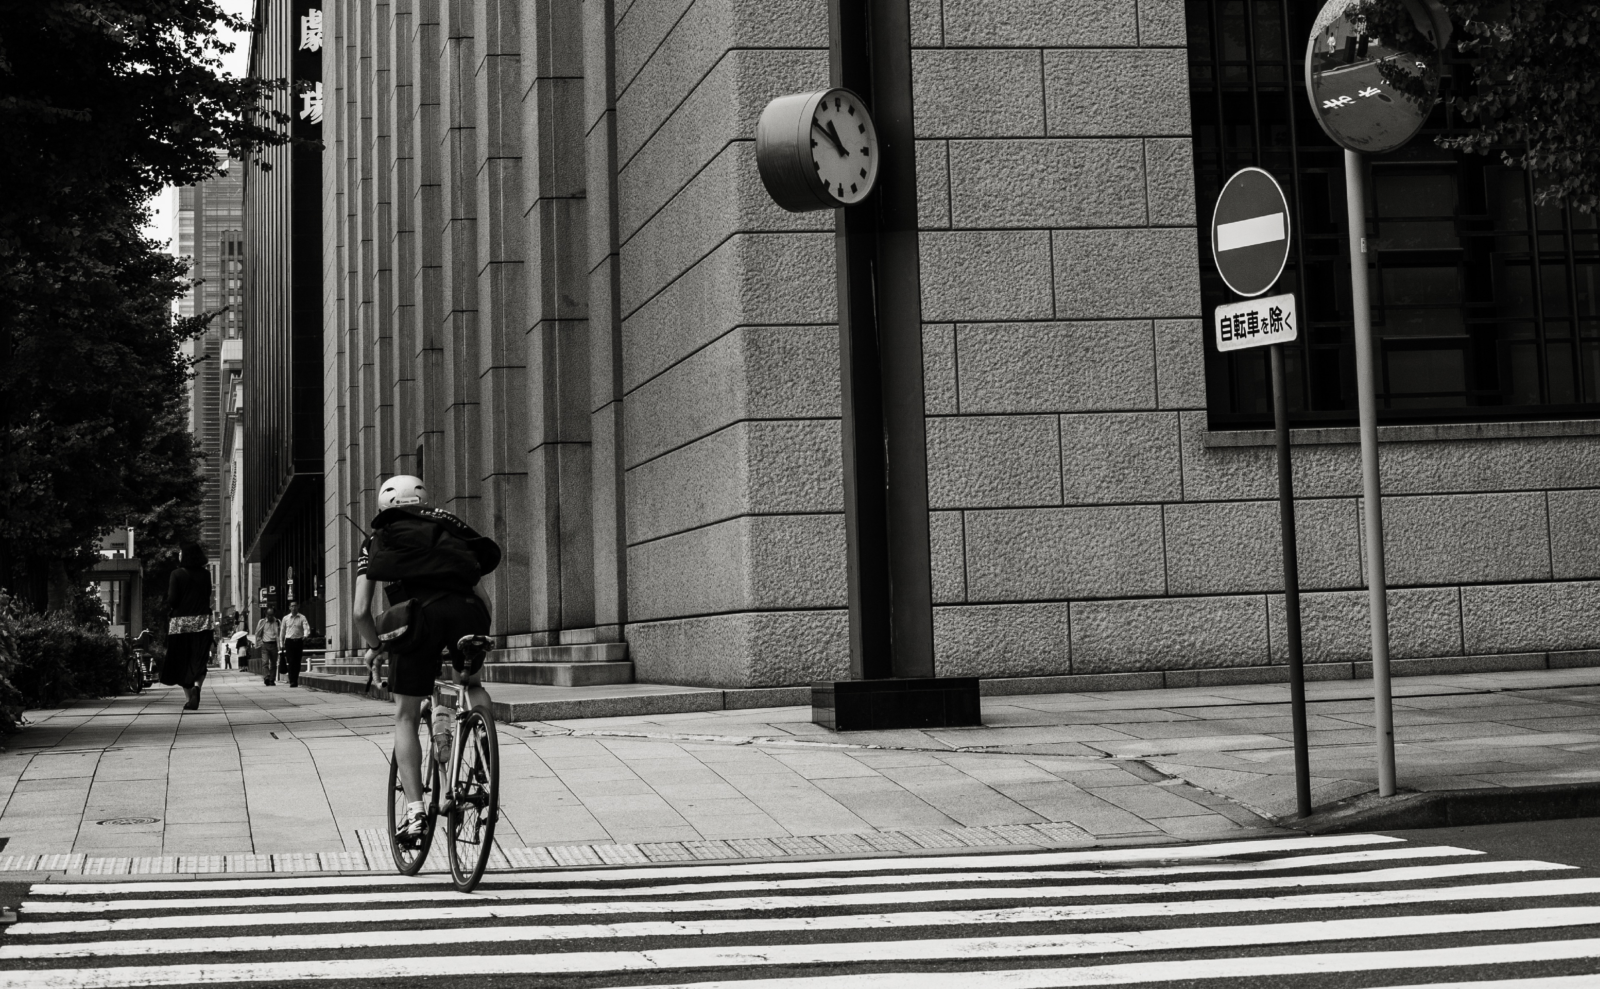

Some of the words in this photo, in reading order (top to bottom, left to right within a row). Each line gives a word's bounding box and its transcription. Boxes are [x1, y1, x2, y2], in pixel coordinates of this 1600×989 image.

[1220, 305, 1293, 342] 自転車を除く
[269, 585, 276, 593] P
